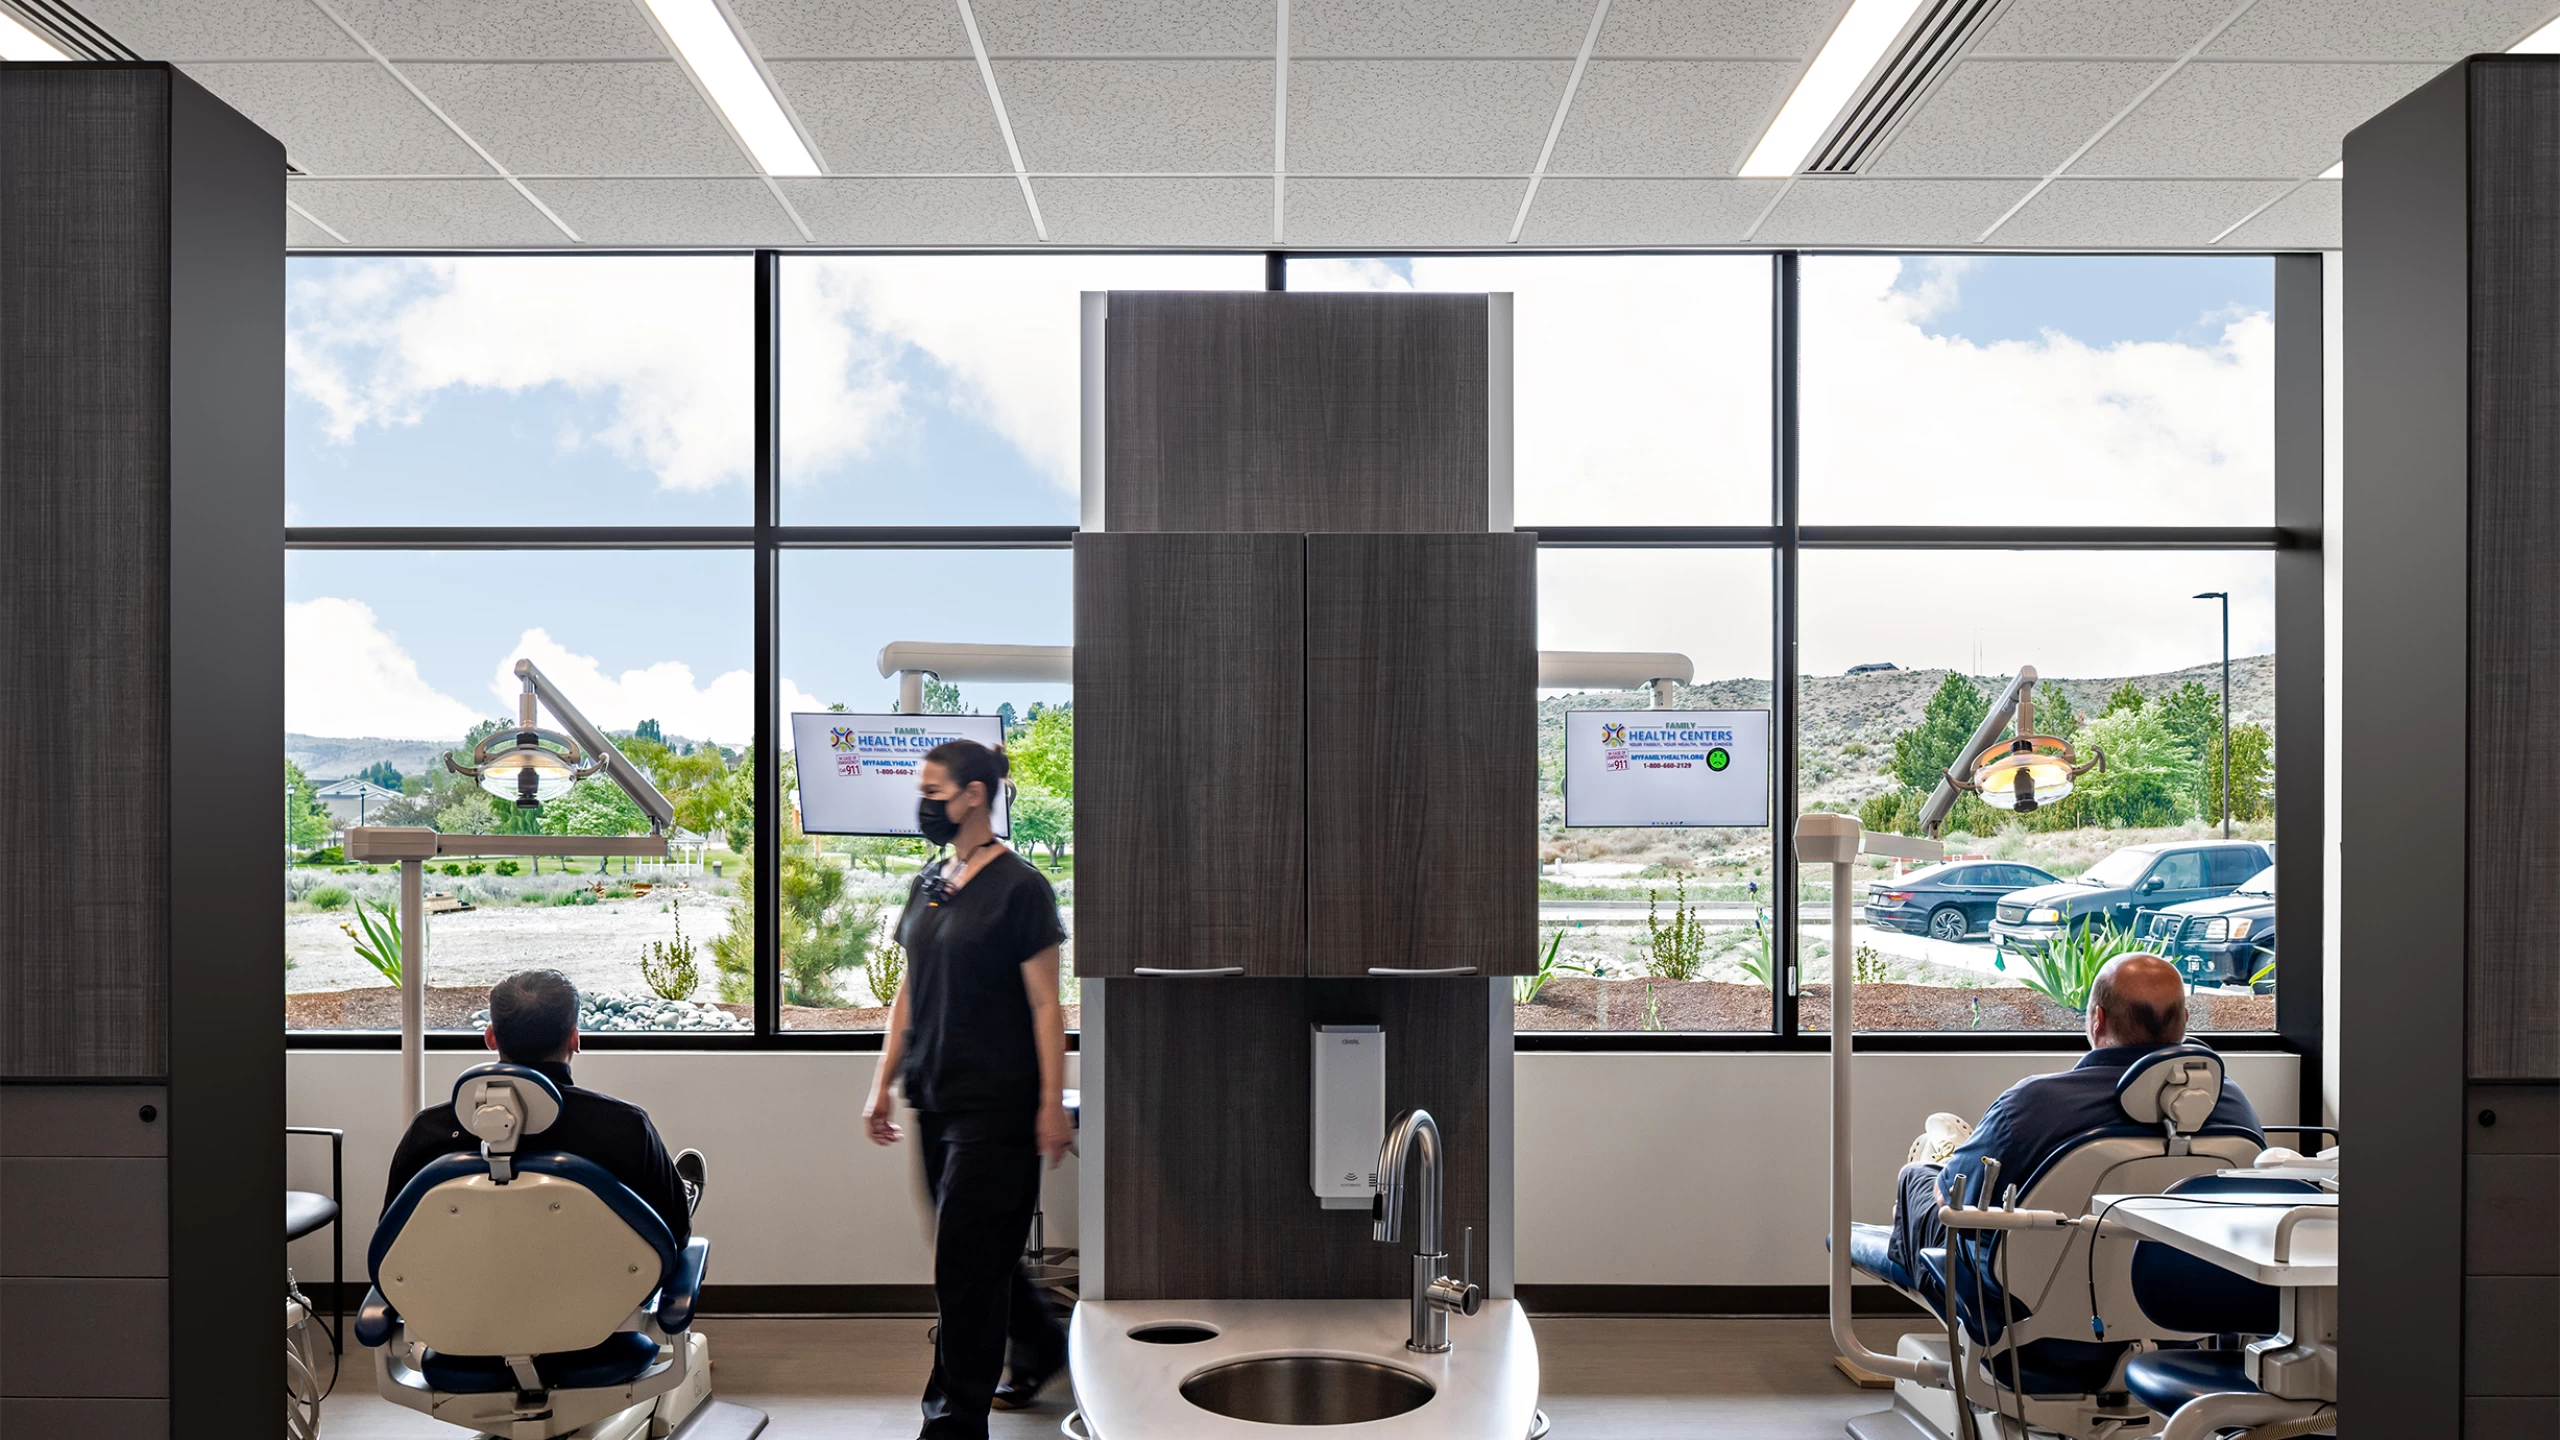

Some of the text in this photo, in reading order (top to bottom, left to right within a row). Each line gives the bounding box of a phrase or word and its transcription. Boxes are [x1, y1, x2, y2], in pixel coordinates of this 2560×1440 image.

[894, 727, 926, 735] FAMILY
[1629, 731, 1733, 741] HEALTH CENTERS
[858, 736, 964, 748] HEALTH CENTE
[846, 765, 860, 775] 911
[1614, 760, 1628, 770] 911
